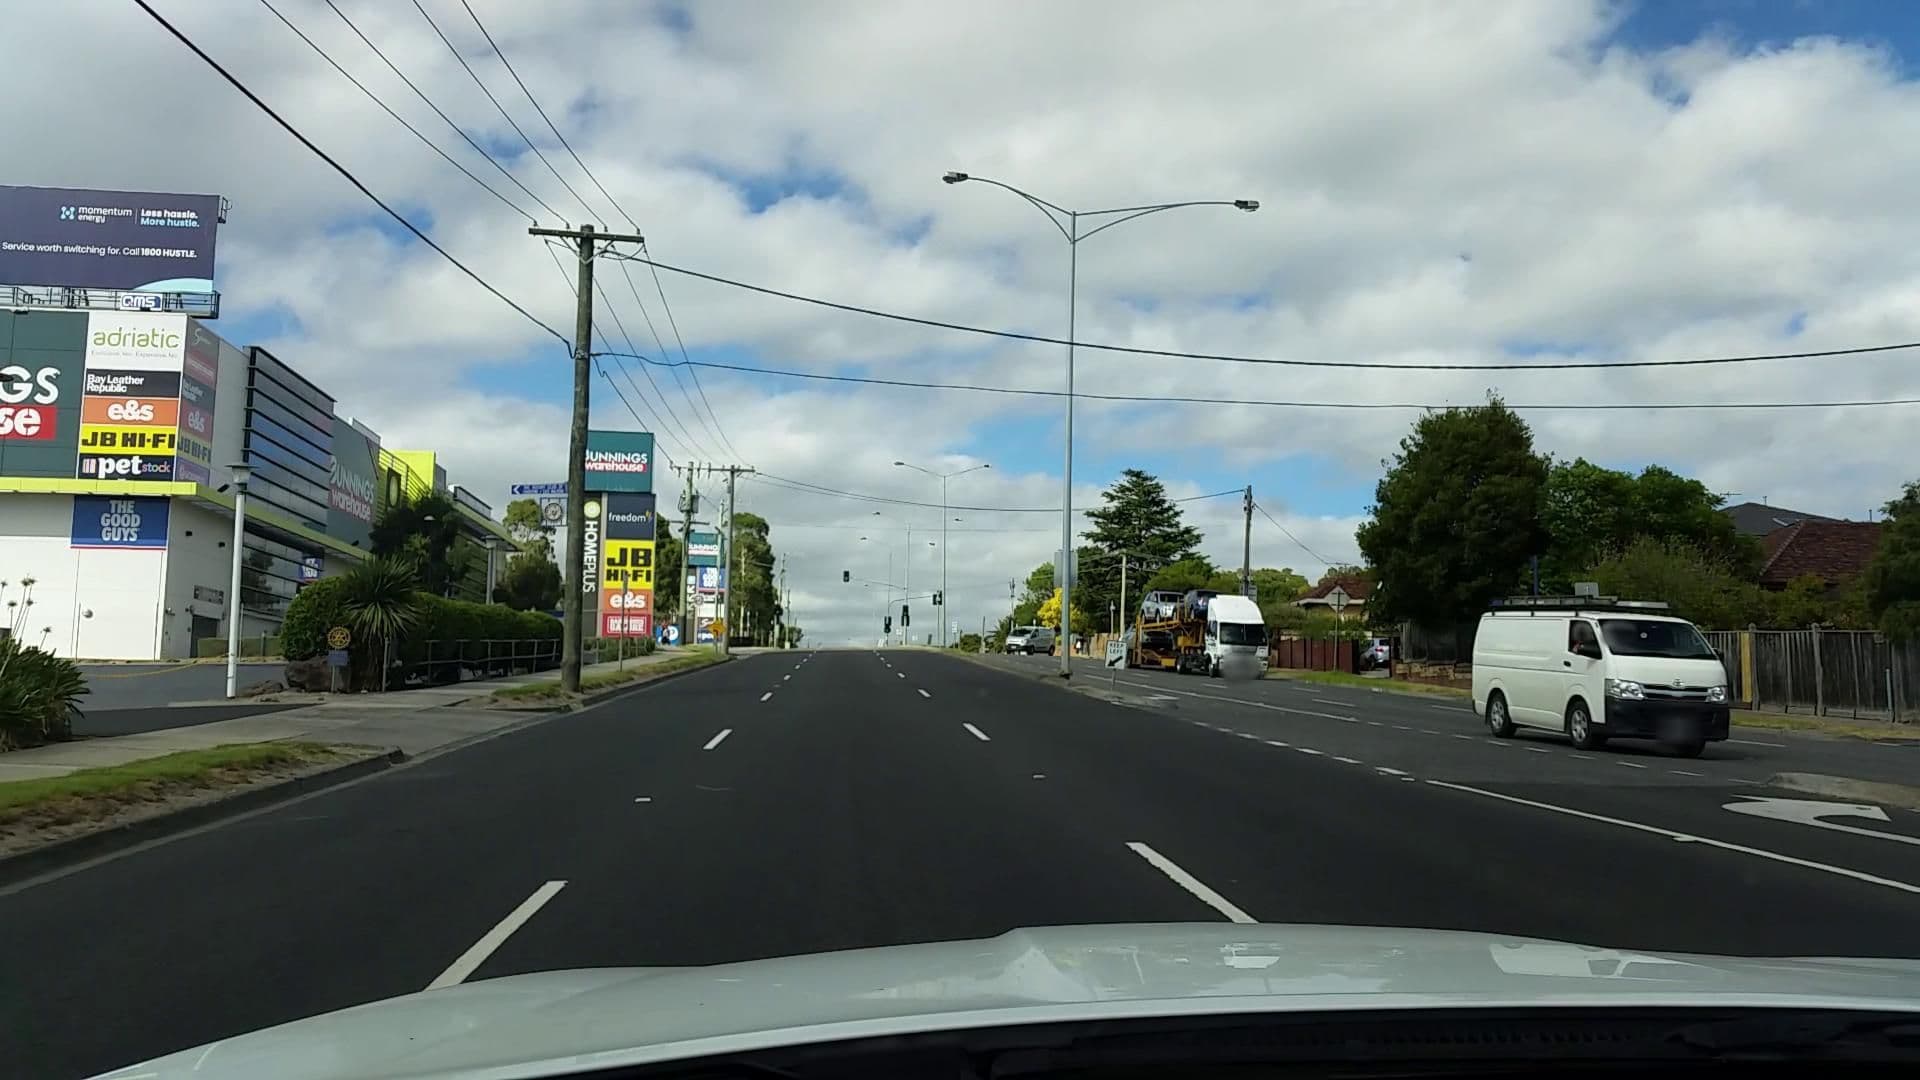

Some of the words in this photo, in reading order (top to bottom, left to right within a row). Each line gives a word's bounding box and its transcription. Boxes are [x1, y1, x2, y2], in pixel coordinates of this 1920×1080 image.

[78, 205, 133, 217] momentum
[141, 208, 162, 218] Less
[163, 209, 199, 219] hassle.
[77, 214, 106, 224] energy
[140, 217, 166, 227] More
[166, 218, 200, 228] hustle.
[2, 241, 35, 252] Service
[36, 242, 62, 253] worth
[63, 243, 106, 257] switching
[107, 245, 121, 255] for.
[122, 246, 140, 256] Call
[141, 247, 162, 257] 1800
[162, 249, 198, 259] HUSTLE.
[93, 326, 180, 349] adriatic
[87, 373, 106, 387] Bay
[106, 374, 144, 386] Leather
[86, 382, 128, 394] Republic
[107, 399, 154, 422] e&s
[81, 431, 118, 448] JB
[585, 461, 644, 473] warehouse
[109, 500, 135, 514] THE
[331, 490, 371, 521] warehouse
[100, 513, 141, 528] GOOD
[608, 511, 647, 523] freedom
[101, 526, 139, 543] GUYS
[582, 520, 599, 593] HOMEPLUS
[606, 548, 652, 567] JB
[610, 591, 646, 608] e&s
